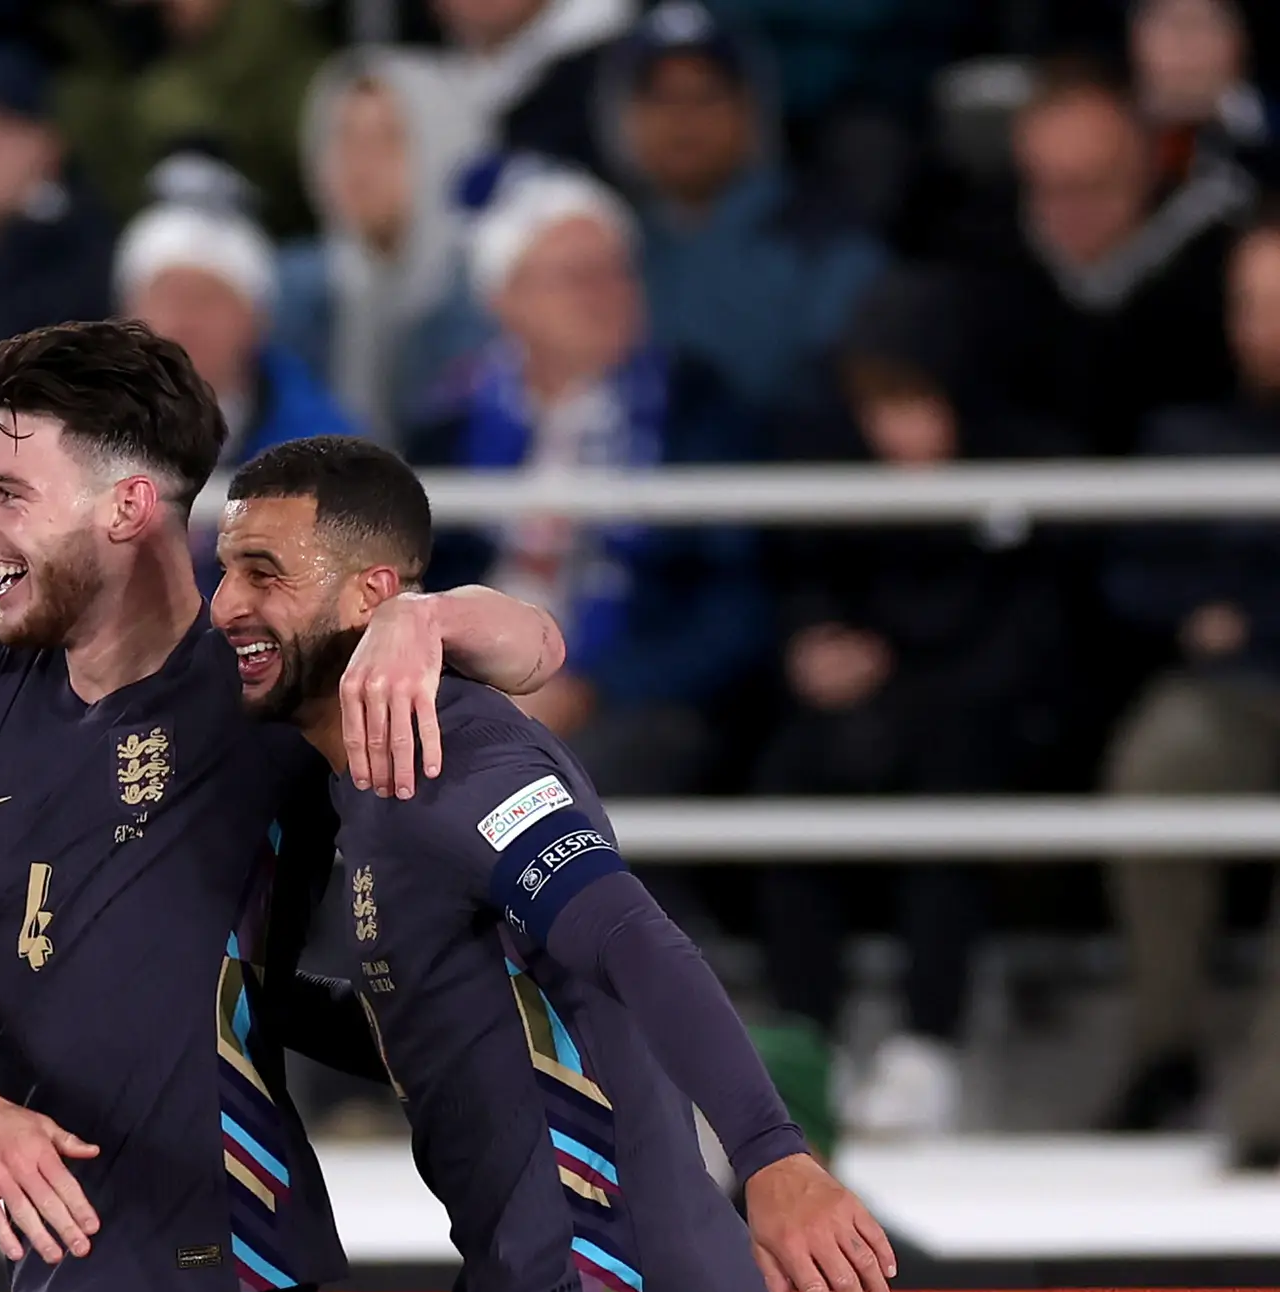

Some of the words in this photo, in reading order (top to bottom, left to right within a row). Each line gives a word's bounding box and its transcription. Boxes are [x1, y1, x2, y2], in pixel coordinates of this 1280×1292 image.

[486, 785, 565, 841] FOUNDATION
[542, 834, 611, 868] RESPEC
[18, 862, 54, 972] 4
